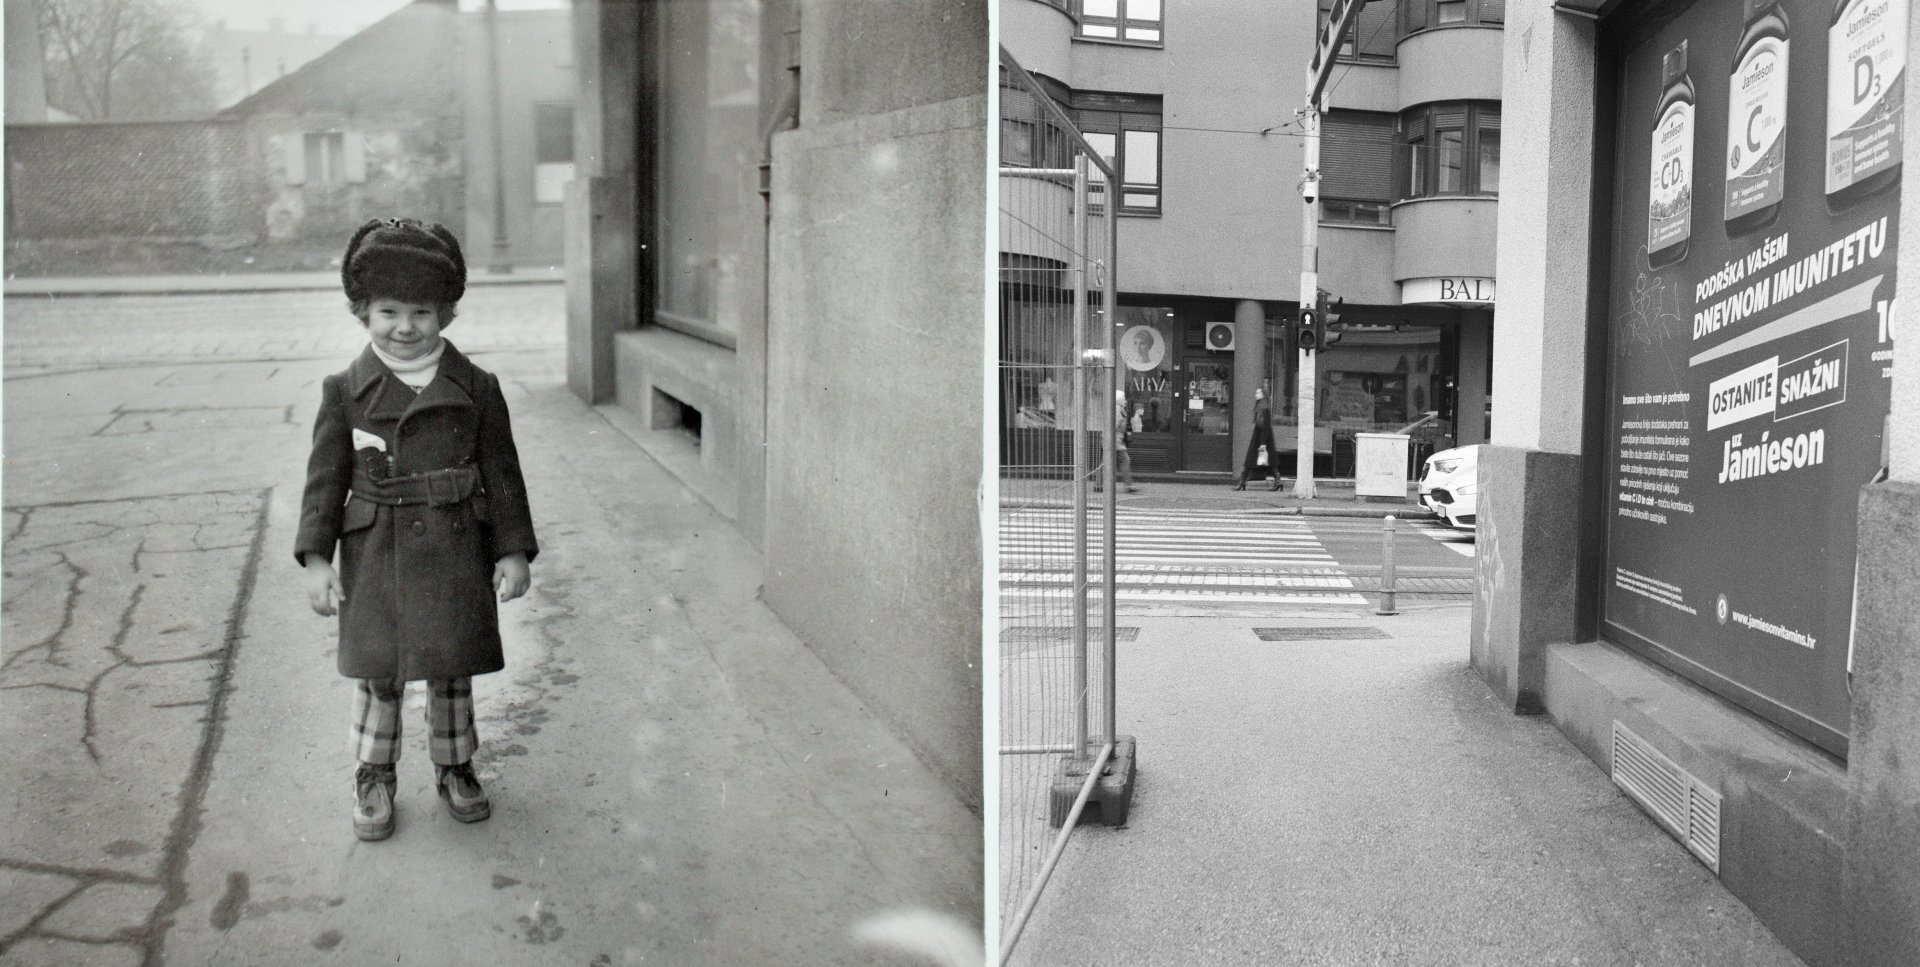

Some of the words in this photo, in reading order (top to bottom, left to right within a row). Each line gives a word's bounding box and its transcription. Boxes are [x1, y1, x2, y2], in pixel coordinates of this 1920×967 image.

[1742, 62, 1774, 90] Jamieson
[1747, 104, 1763, 153] C
[1693, 284, 1770, 341] DNEVNOM
[1772, 216, 1888, 305] IMUNITETU
[1696, 260, 1745, 303] PODRŠKA
[1746, 232, 1788, 276] VAŠEM
[1712, 373, 1773, 415] OSTANITE
[1780, 358, 1841, 405] SNAŽNI
[1718, 428, 1825, 484] Jamieson
[1731, 434, 1743, 447] uz
